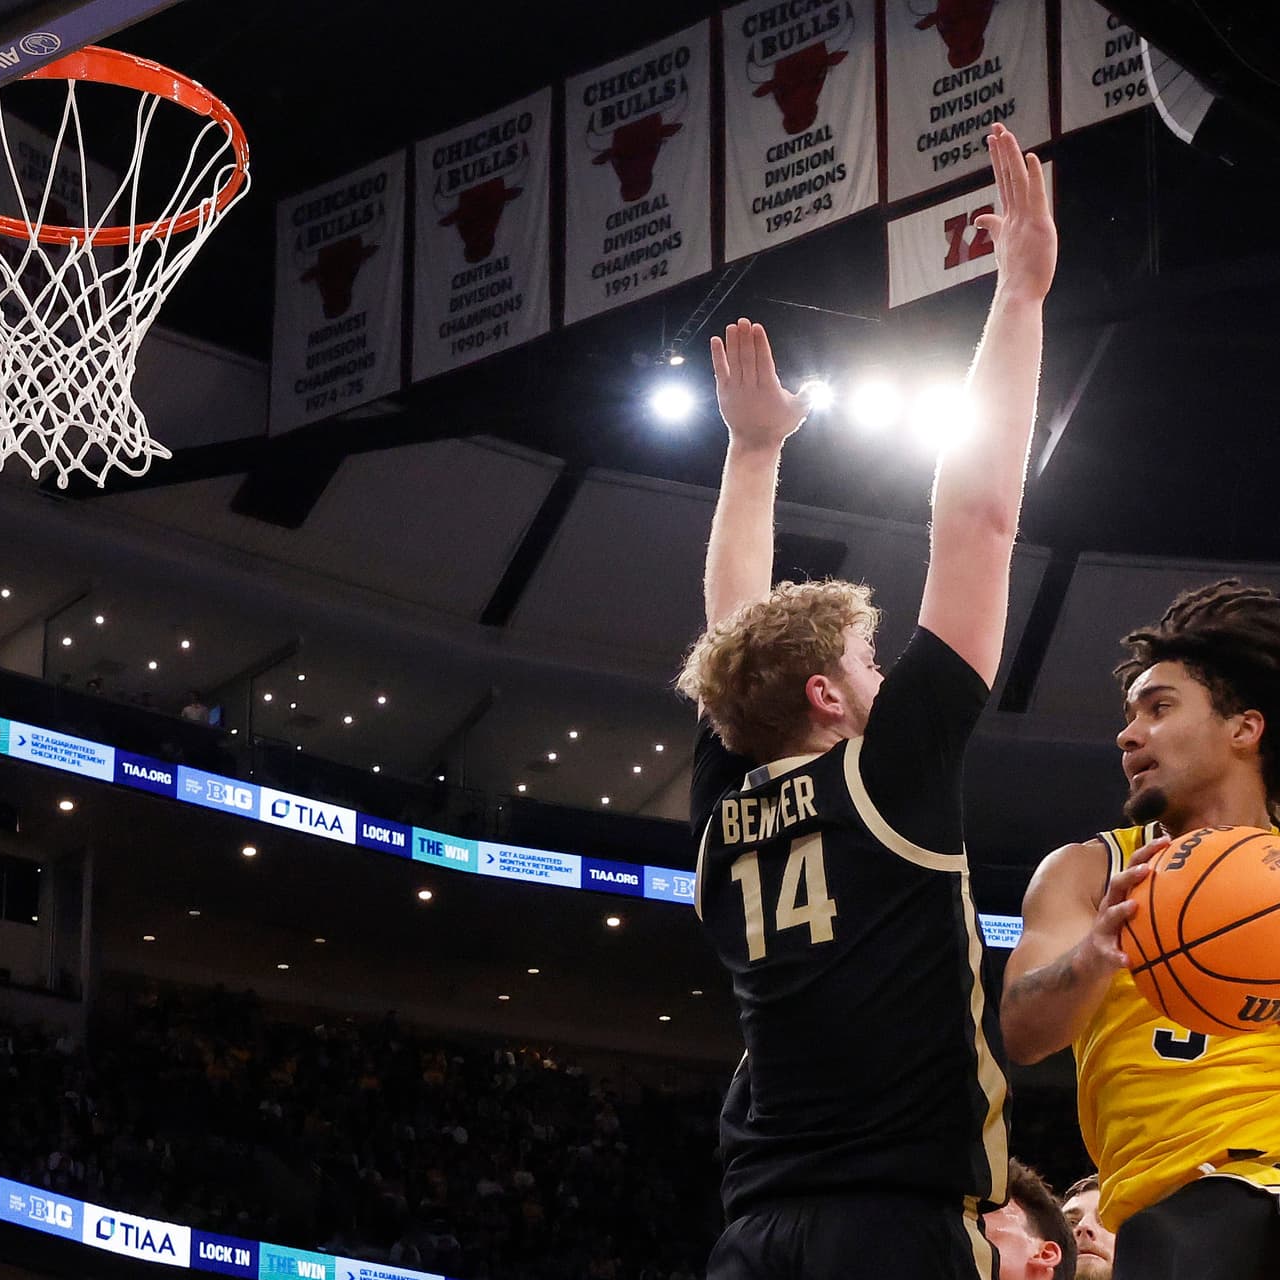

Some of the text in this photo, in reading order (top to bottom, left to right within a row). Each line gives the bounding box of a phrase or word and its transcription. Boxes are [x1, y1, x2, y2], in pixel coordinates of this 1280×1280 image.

[761, 6, 840, 59] BULLS
[583, 47, 690, 106] CHICAGO
[932, 57, 1001, 96] CENTRAL
[600, 80, 675, 128] BULLS
[930, 79, 1003, 123] DIVISION
[432, 112, 532, 170] CHICAGO
[767, 126, 832, 163] CENTRAL
[917, 99, 1015, 152] CHAMPIONS
[447, 144, 518, 191] BULLS
[765, 147, 834, 188] DIVISION
[932, 135, 990, 171] 1995-9
[752, 165, 846, 214] CHAMPIONS
[606, 194, 669, 231] CENTRAL
[766, 194, 832, 233] 1992-93
[603, 215, 671, 254] DIVISION
[451, 256, 509, 291] CENTRAL
[591, 232, 682, 279] CHAMPIONS
[449, 277, 513, 312] DIVISION
[606, 261, 668, 297] 1991-92
[439, 295, 522, 338] CHAMPIONS
[295, 804, 344, 835] TIAA
[363, 823, 470, 863] LOCK IN THE WIN
[589, 868, 638, 888] TIAA.ORG
[731, 832, 837, 961] 14
